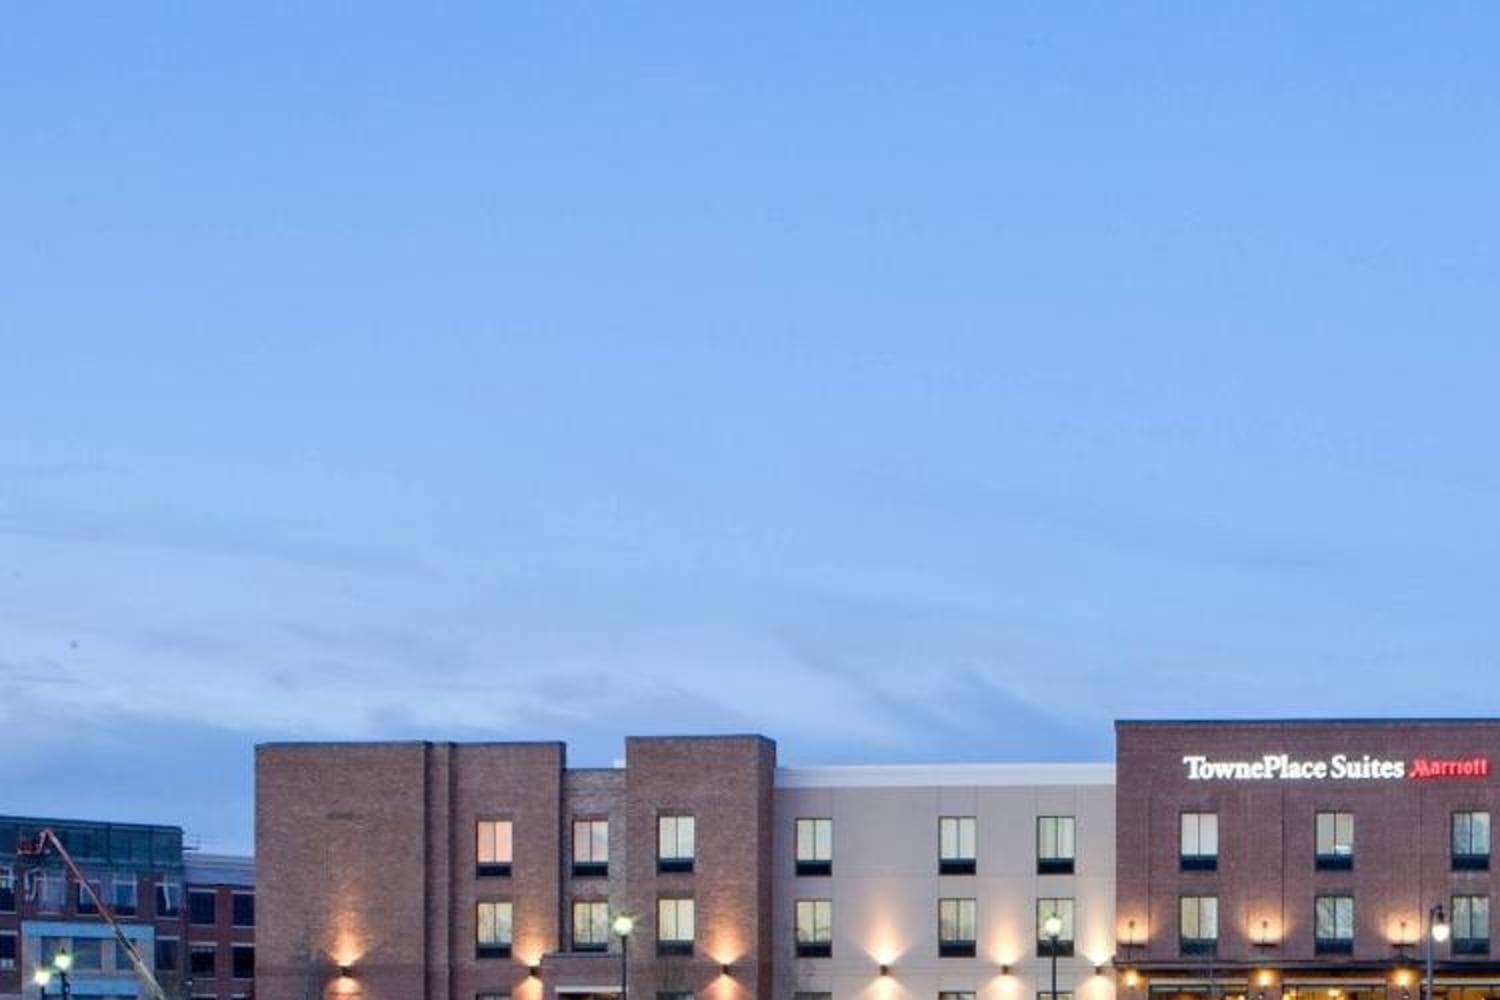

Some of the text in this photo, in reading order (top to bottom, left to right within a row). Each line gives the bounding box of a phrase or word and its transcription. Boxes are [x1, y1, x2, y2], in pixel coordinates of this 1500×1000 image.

[1182, 753, 1488, 780] TownePlace Suites Marriott
